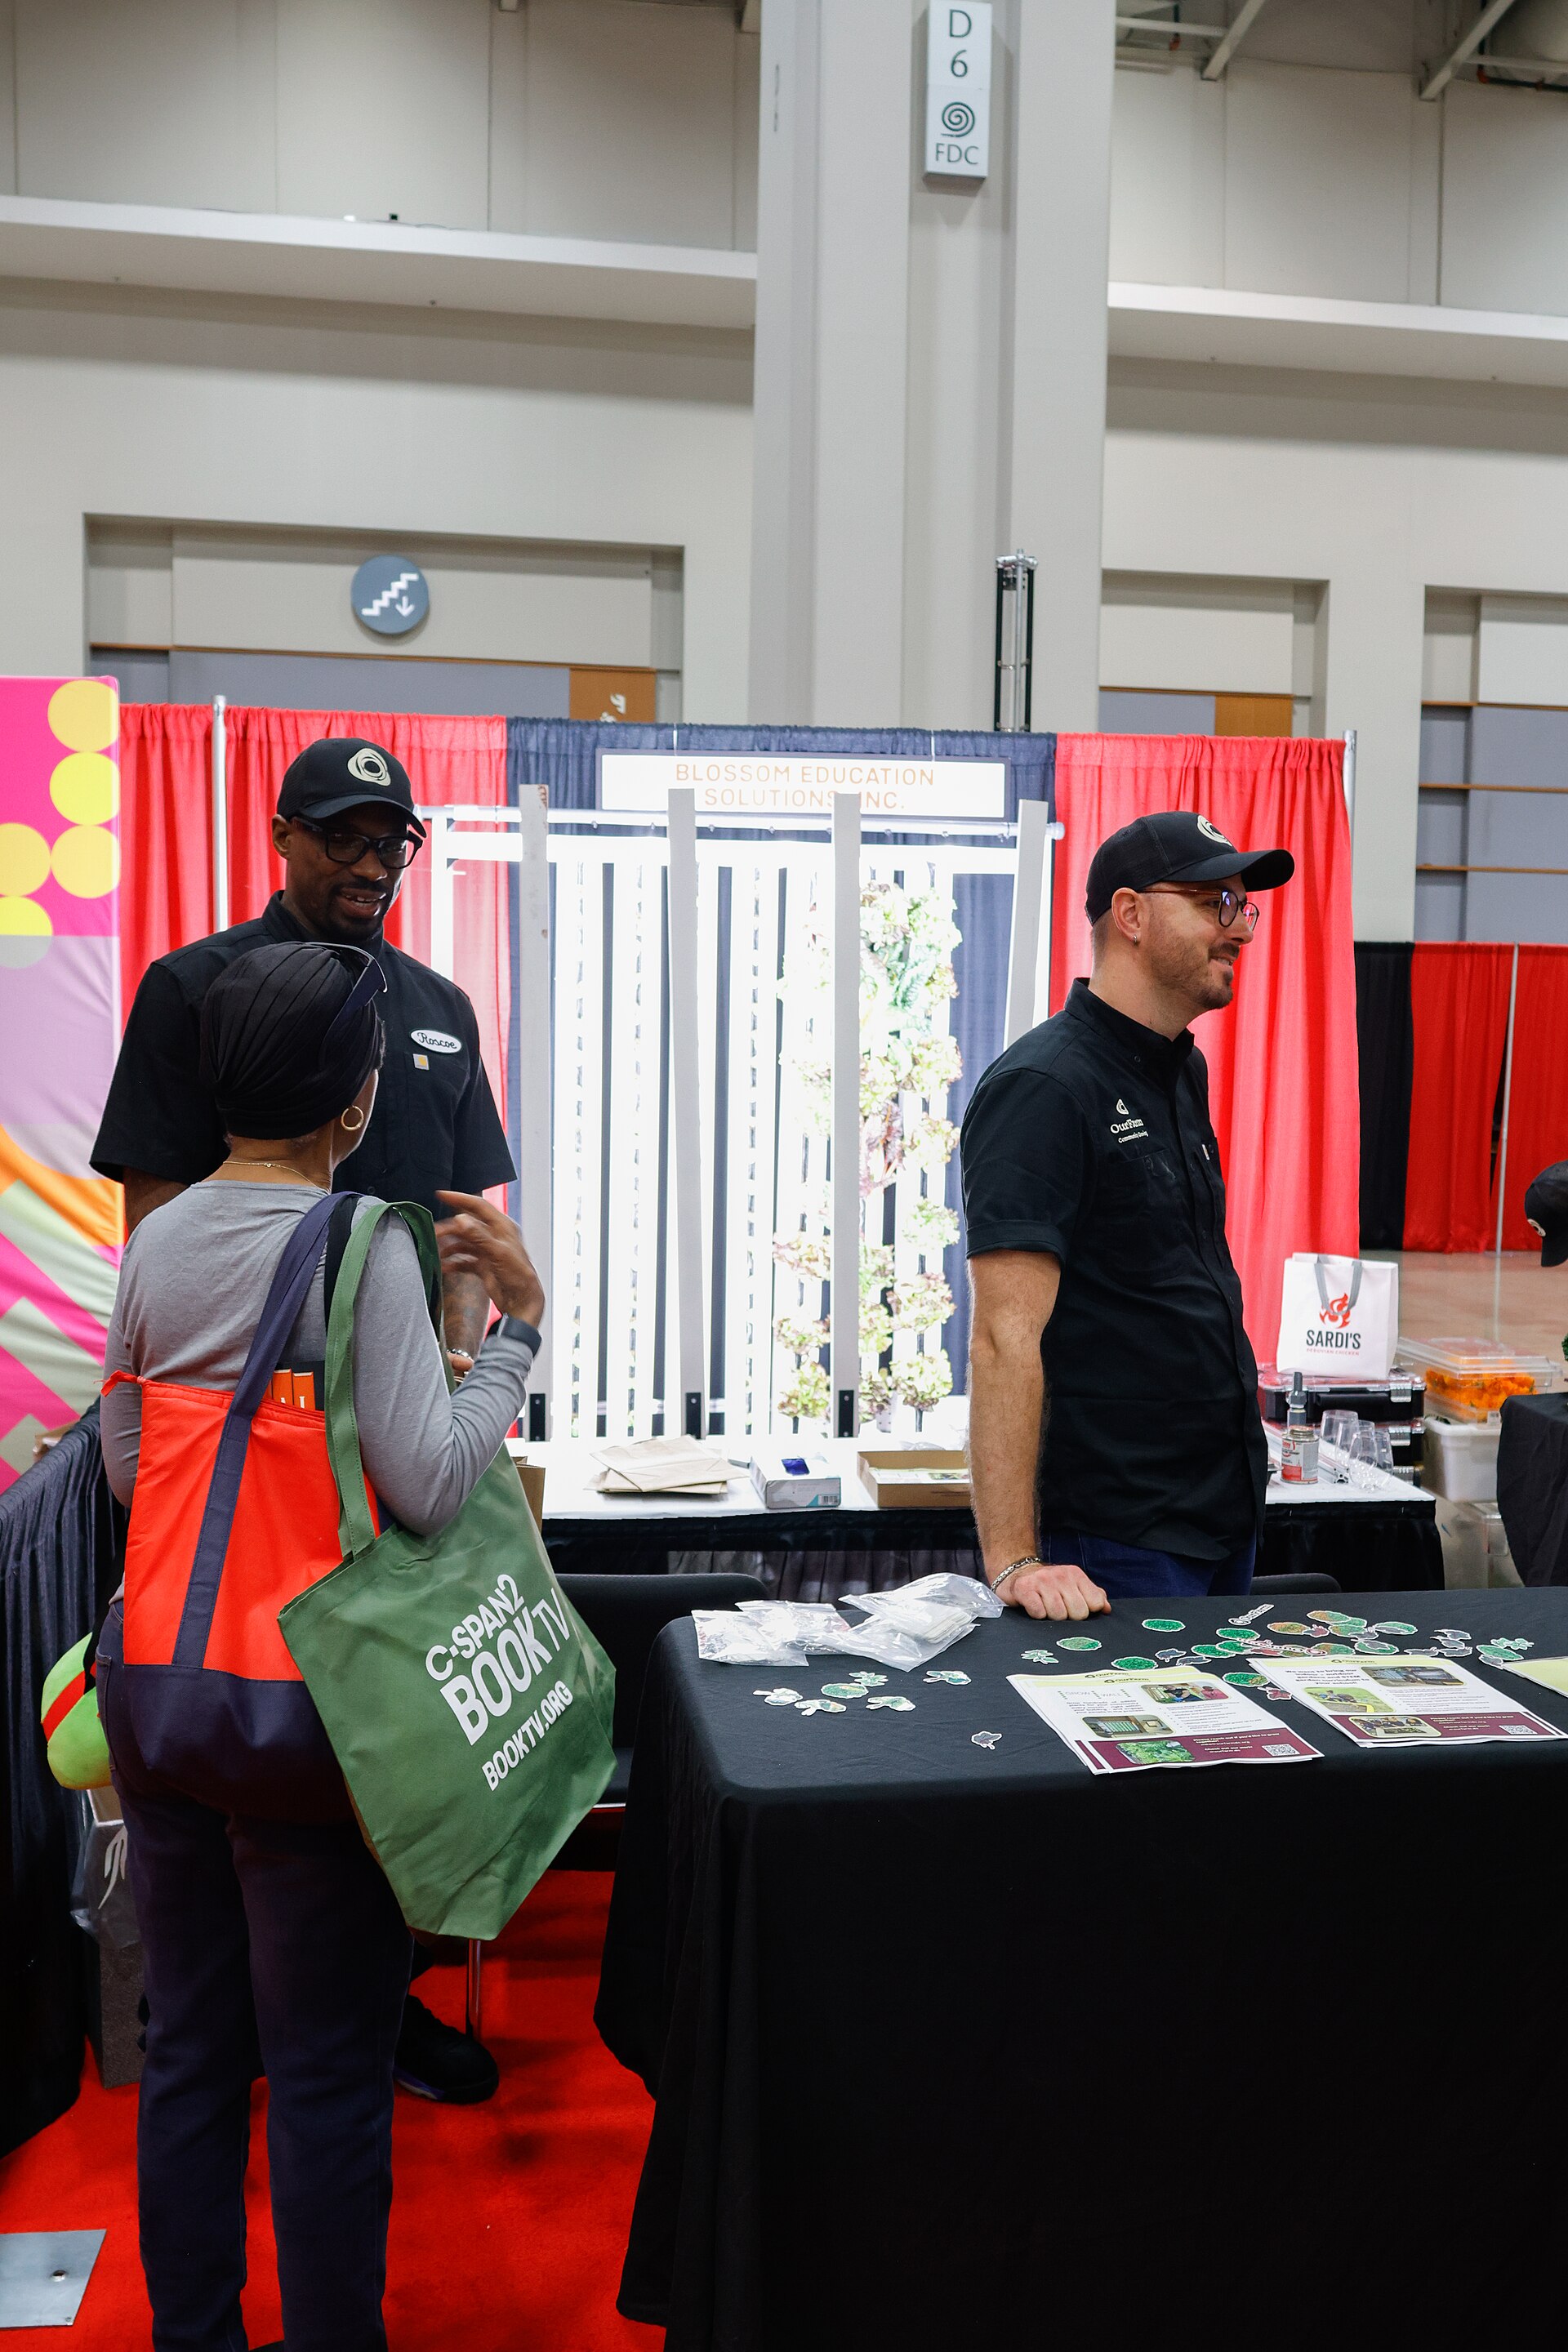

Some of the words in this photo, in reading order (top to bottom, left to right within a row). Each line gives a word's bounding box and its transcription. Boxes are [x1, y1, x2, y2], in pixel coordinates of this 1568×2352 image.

[949, 9, 972, 38] D
[951, 49, 968, 78] 6
[935, 142, 979, 165] FDC
[675, 764, 791, 783] BLOSSOM
[800, 766, 935, 786] EDUCATION
[416, 1031, 457, 1049] Roscoe
[1306, 1330, 1361, 1350] SARDI'S
[439, 1606, 553, 1746] BOOK
[531, 1588, 570, 1652] TV
[481, 1680, 573, 1792] BOOKTV.ORG
